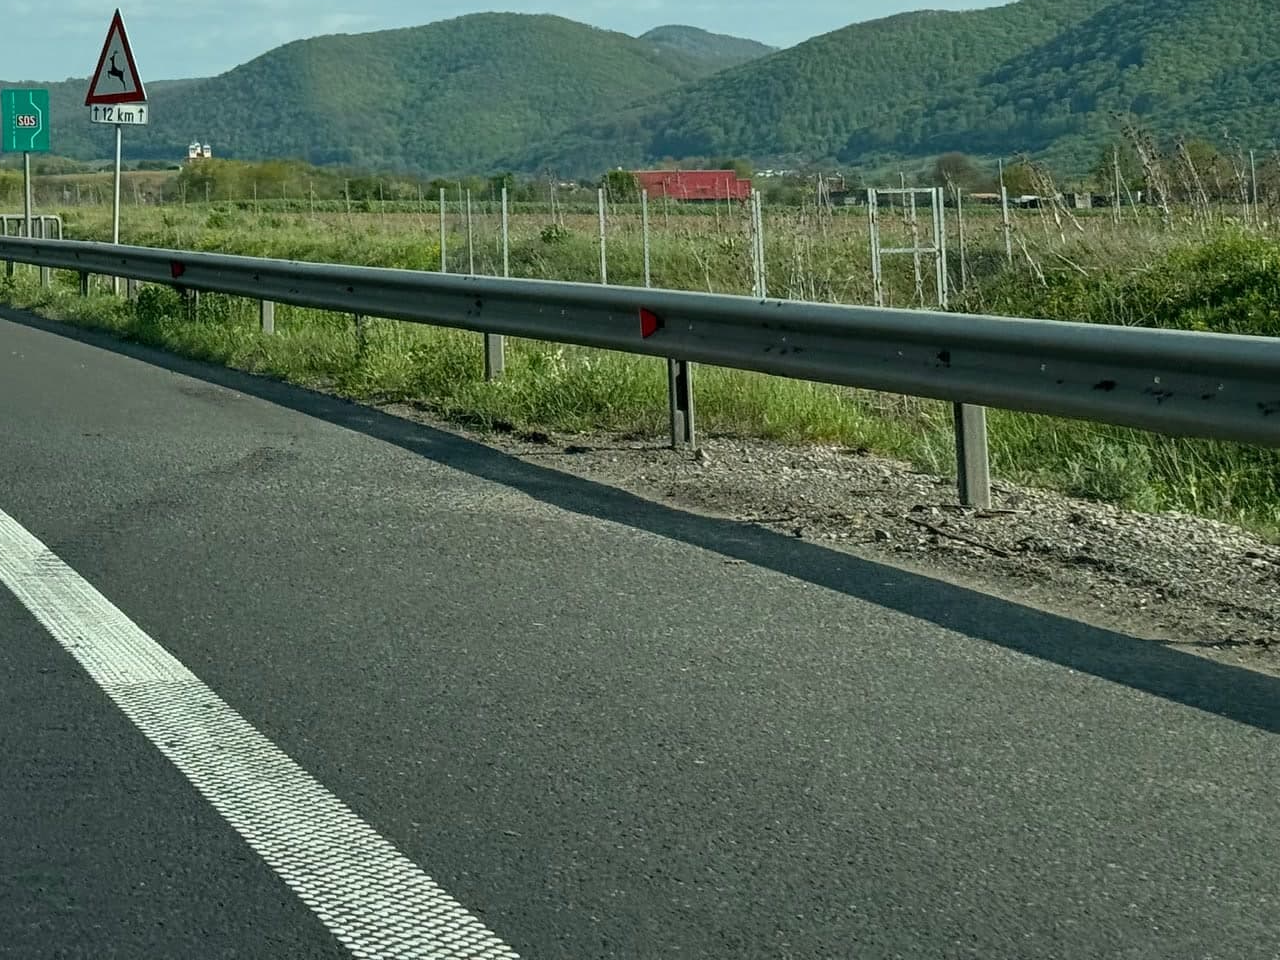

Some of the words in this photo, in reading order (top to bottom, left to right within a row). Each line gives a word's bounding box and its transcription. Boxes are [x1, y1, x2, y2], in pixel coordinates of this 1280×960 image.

[18, 115, 36, 126] SOS
[102, 108, 113, 122] 12
[117, 108, 134, 122] km
